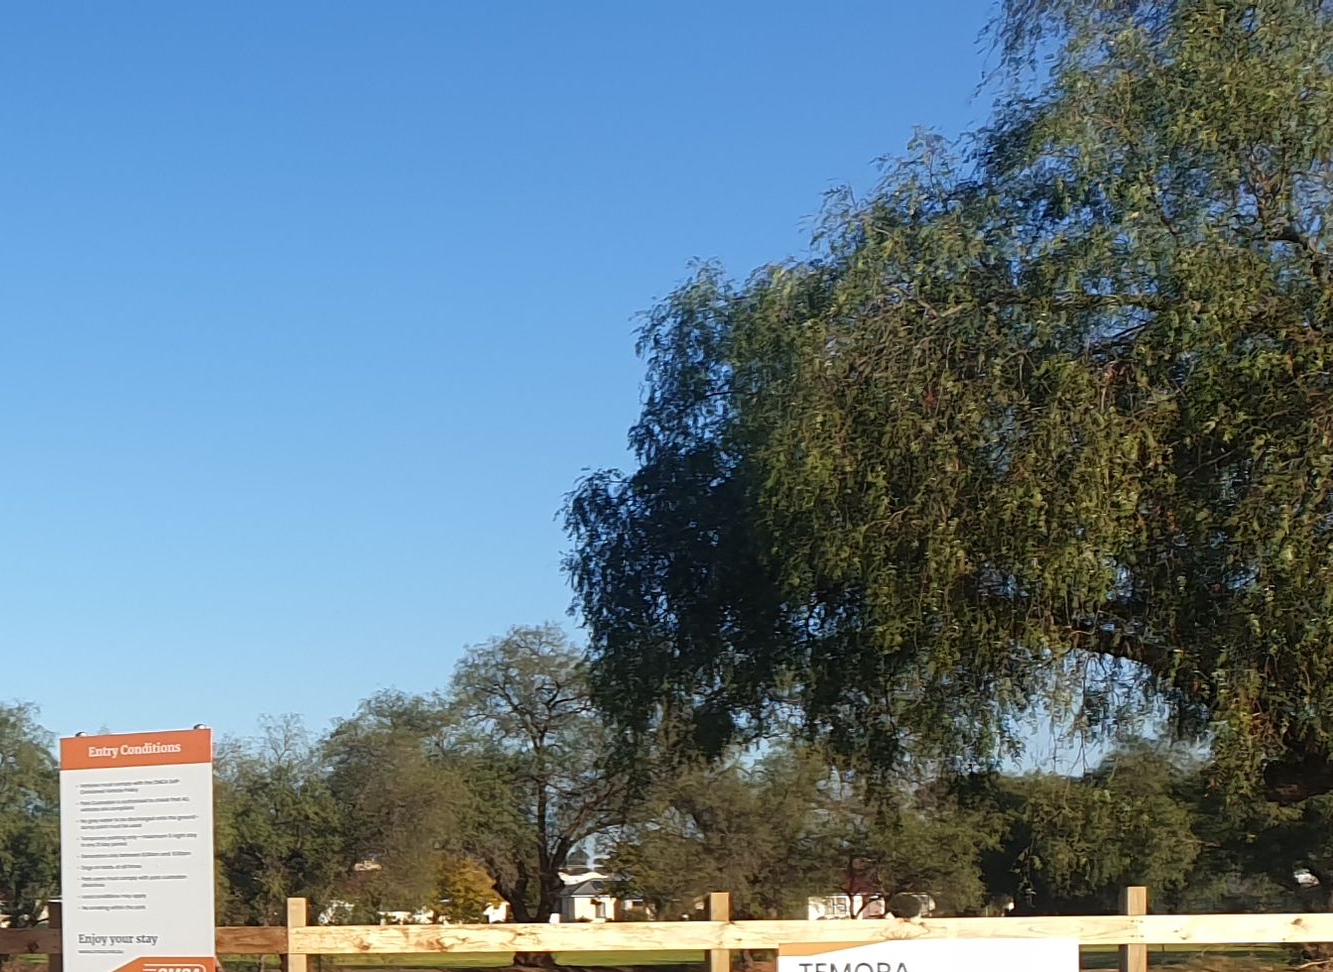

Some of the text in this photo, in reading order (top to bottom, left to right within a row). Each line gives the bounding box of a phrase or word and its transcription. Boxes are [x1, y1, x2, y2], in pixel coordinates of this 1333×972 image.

[88, 742, 181, 759] Entry Conditions
[78, 933, 158, 946] Enjoy your stay
